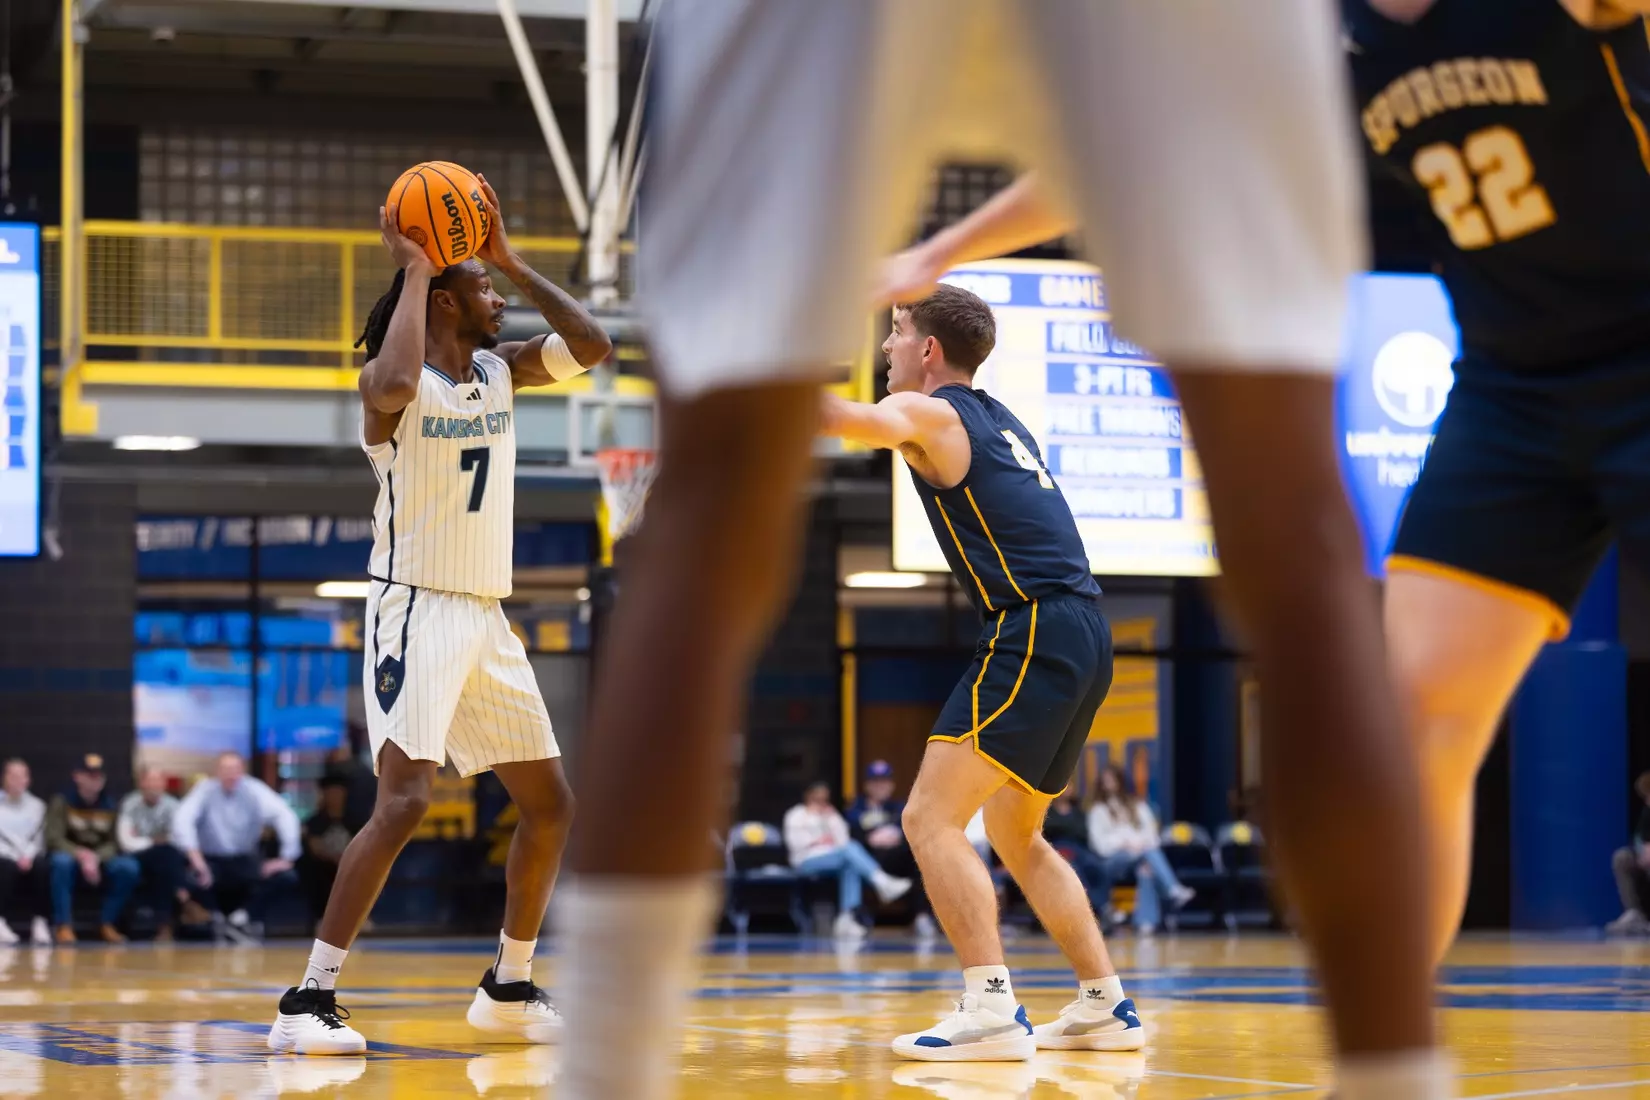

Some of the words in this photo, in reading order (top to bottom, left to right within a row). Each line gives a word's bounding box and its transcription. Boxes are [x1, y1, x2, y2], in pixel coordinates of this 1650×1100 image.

[1361, 57, 1547, 154] SPURGEON
[1411, 124, 1557, 250] 22
[441, 191, 469, 260] Wilson
[422, 415, 484, 439] KANSAS
[486, 411, 511, 435] CITY
[461, 446, 490, 513] 7
[1001, 429, 1055, 489] 4
[984, 986, 1007, 995] adidas
